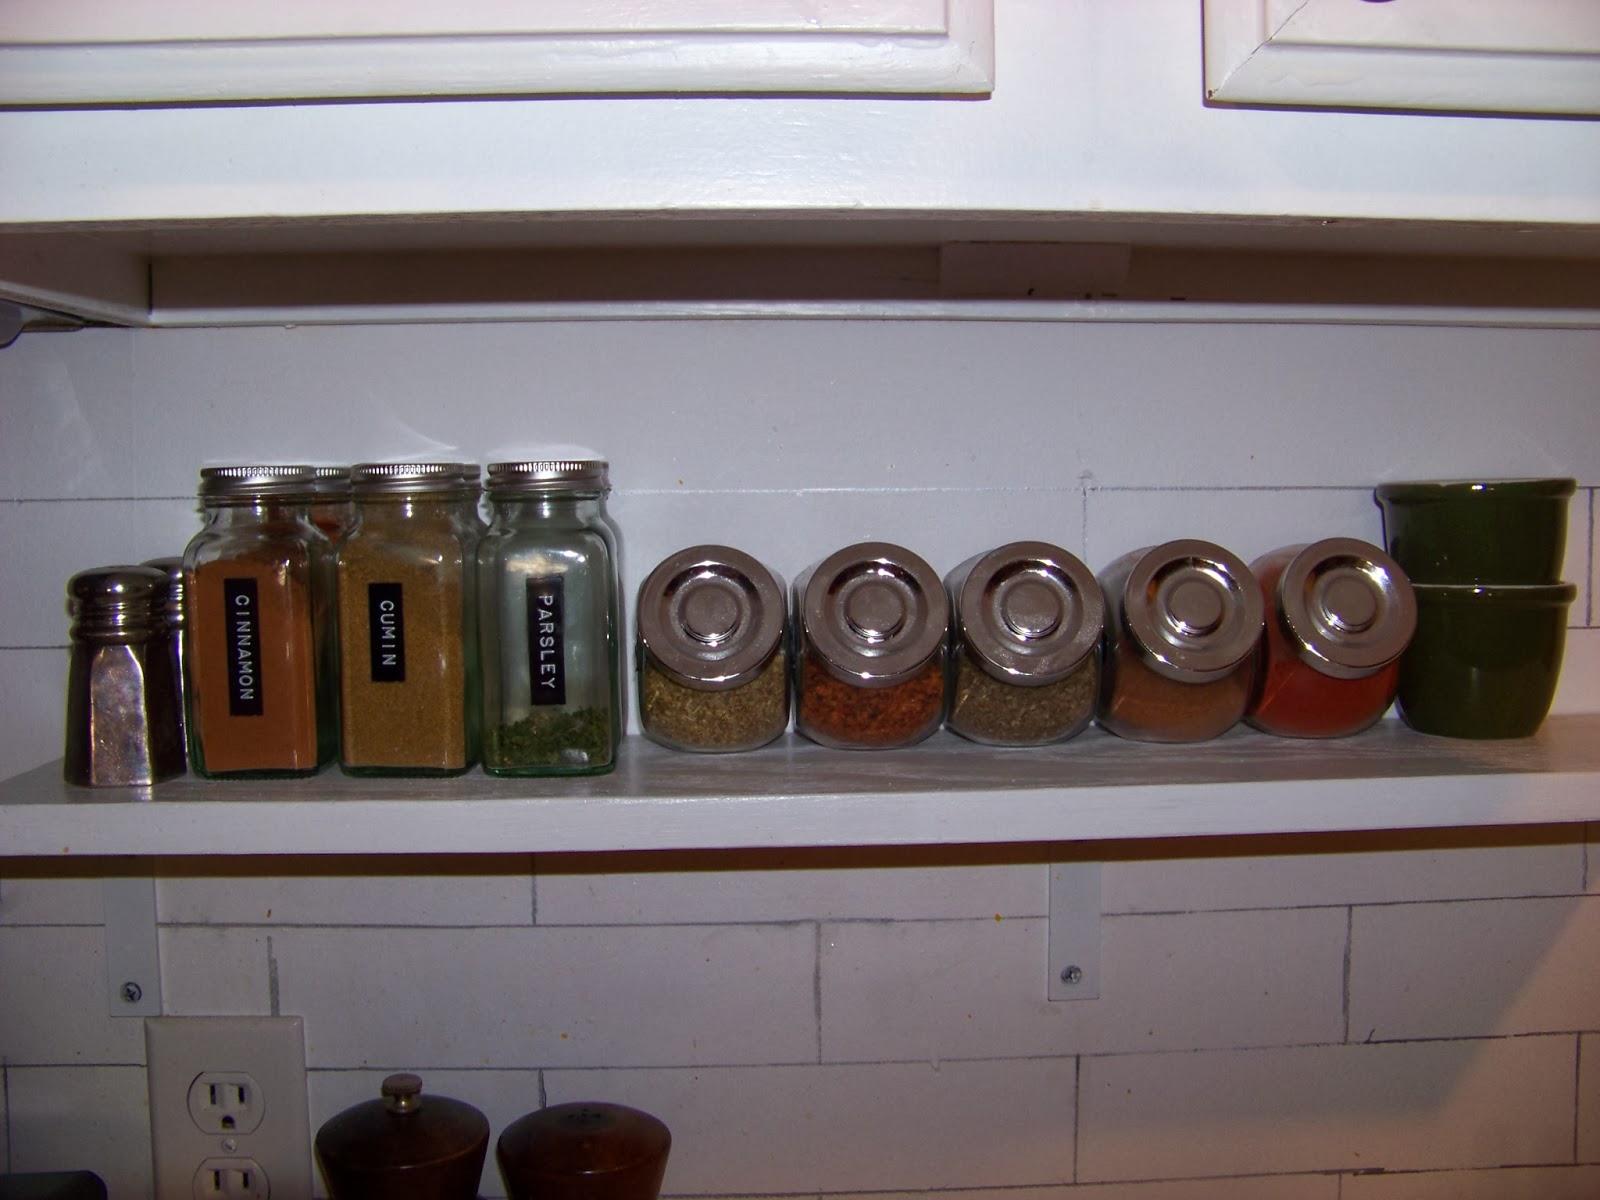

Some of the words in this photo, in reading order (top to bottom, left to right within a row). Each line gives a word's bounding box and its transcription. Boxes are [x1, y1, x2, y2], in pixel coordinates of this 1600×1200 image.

[235, 594, 254, 700] CINNAMON
[380, 600, 396, 665] CUMIN
[538, 595, 556, 689] PARSLEY
